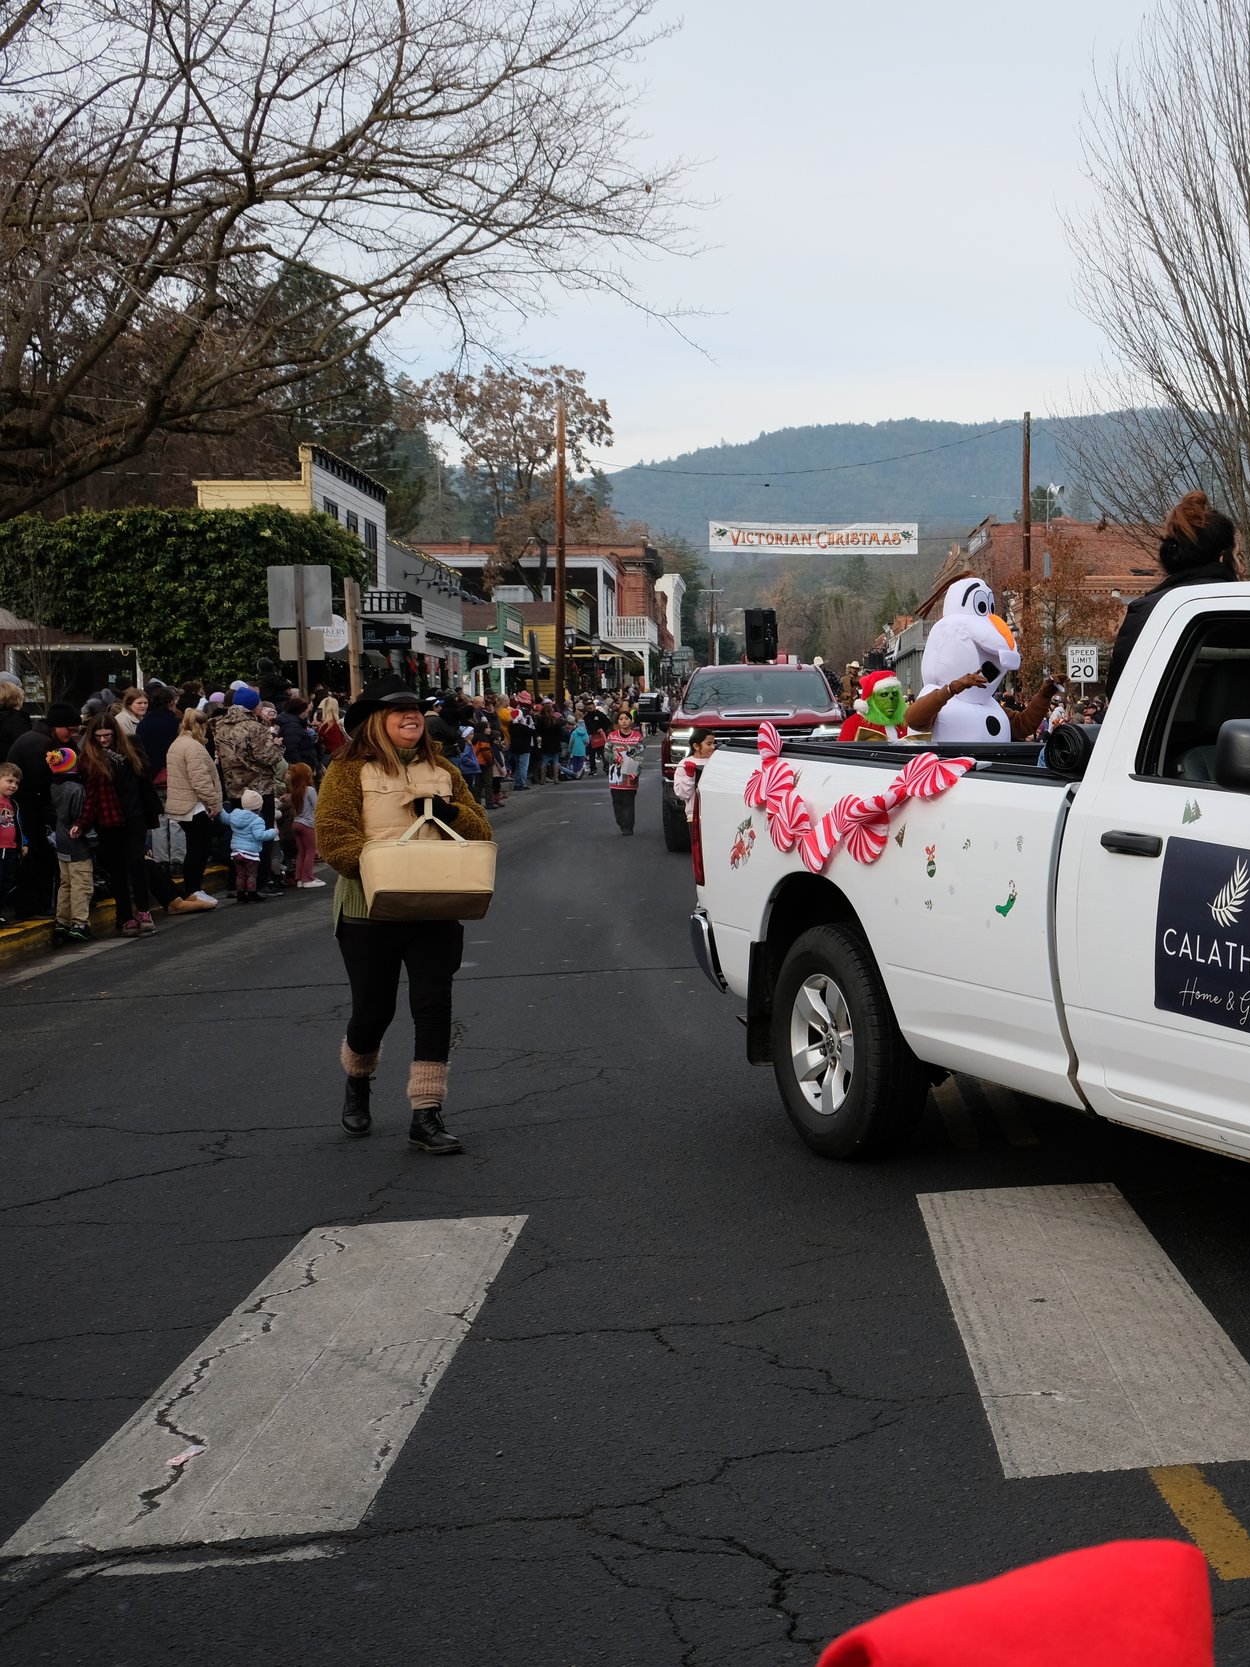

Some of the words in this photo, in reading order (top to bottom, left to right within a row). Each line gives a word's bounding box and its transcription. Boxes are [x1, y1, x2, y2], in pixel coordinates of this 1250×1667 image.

[730, 529, 812, 546] VICTORIAN
[815, 530, 902, 549] CHRISTMAS
[1071, 665, 1094, 678] 20
[1179, 977, 1222, 1007] Home
[1226, 990, 1235, 1011] &
